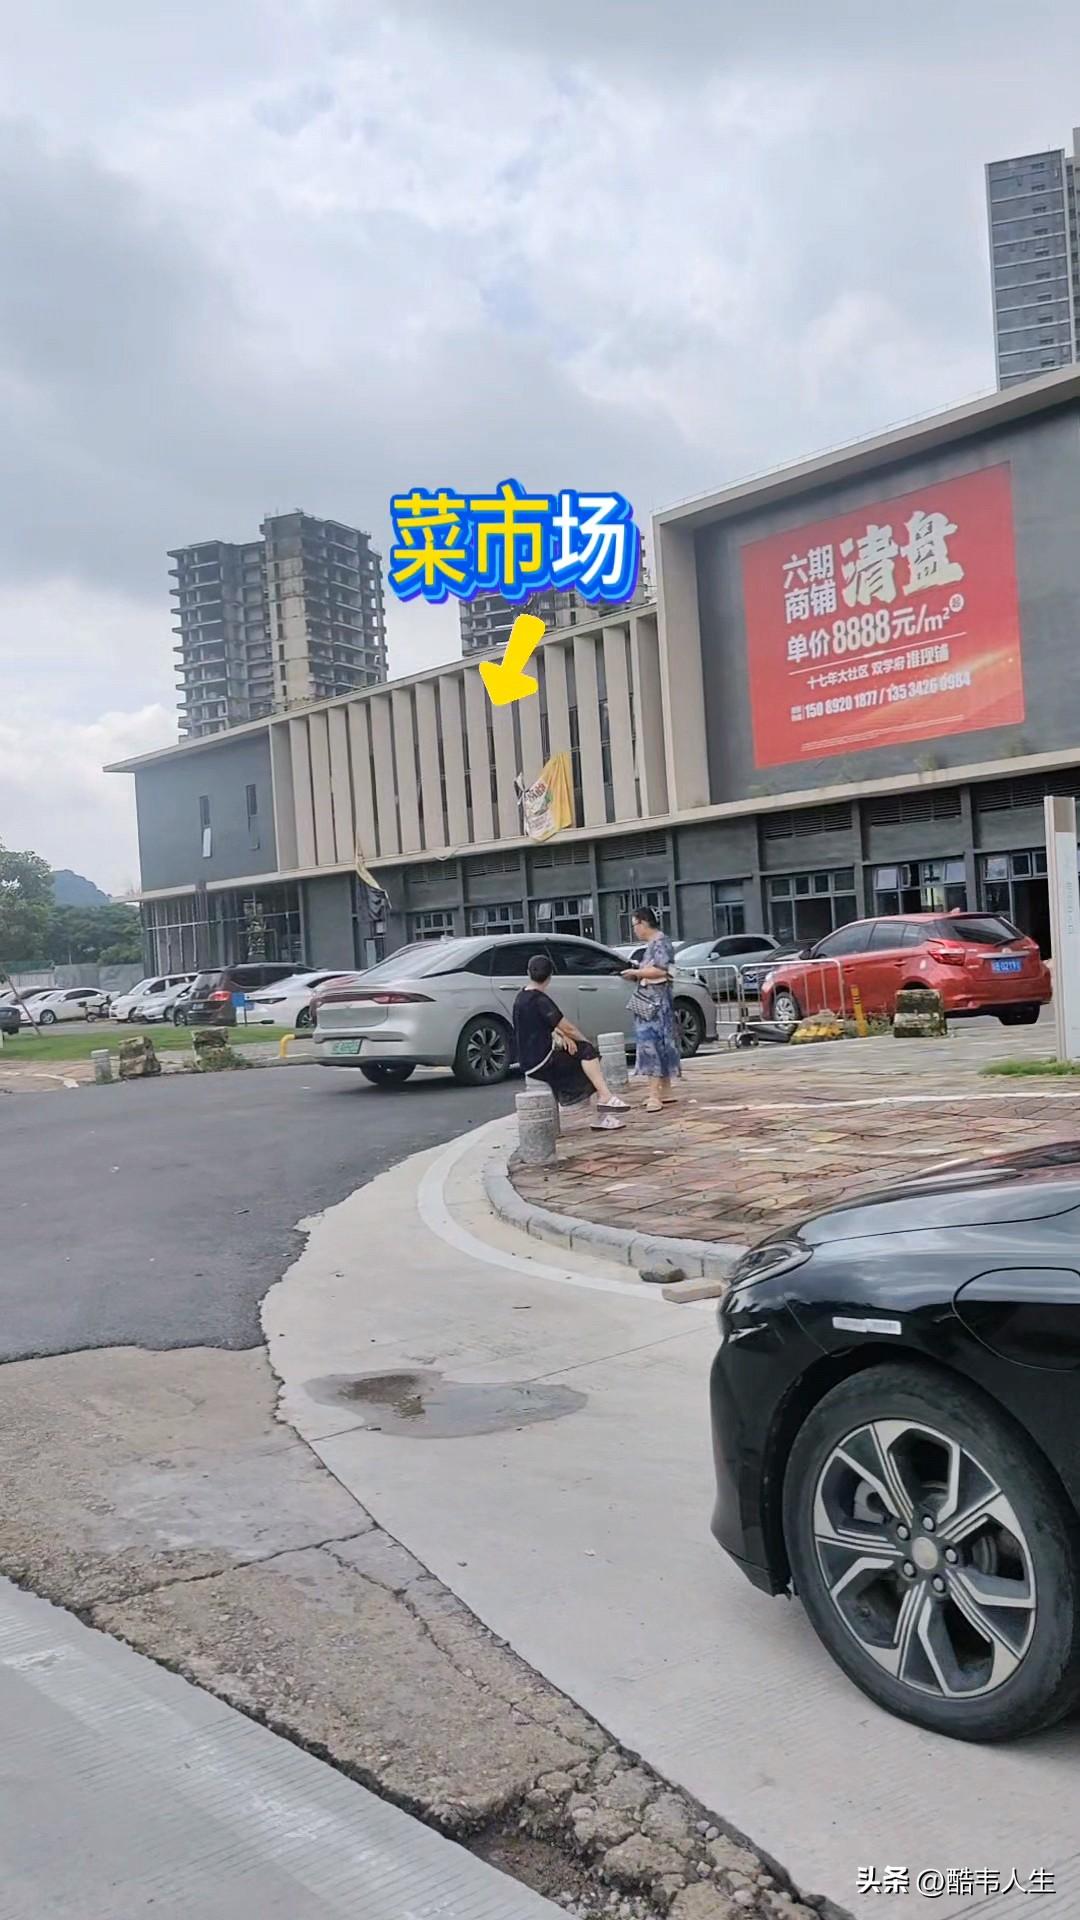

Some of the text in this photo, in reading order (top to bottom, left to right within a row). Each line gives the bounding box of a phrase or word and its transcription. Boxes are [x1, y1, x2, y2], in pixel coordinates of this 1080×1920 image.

[782, 544, 835, 588] 六期
[840, 511, 964, 607] 清盘
[784, 579, 837, 624] 商铺
[807, 664, 869, 690] 十七年大社区
[805, 702, 823, 718] 150
[825, 696, 852, 714] 8920
[854, 690, 878, 707] 1877
[886, 685, 907, 702] 135
